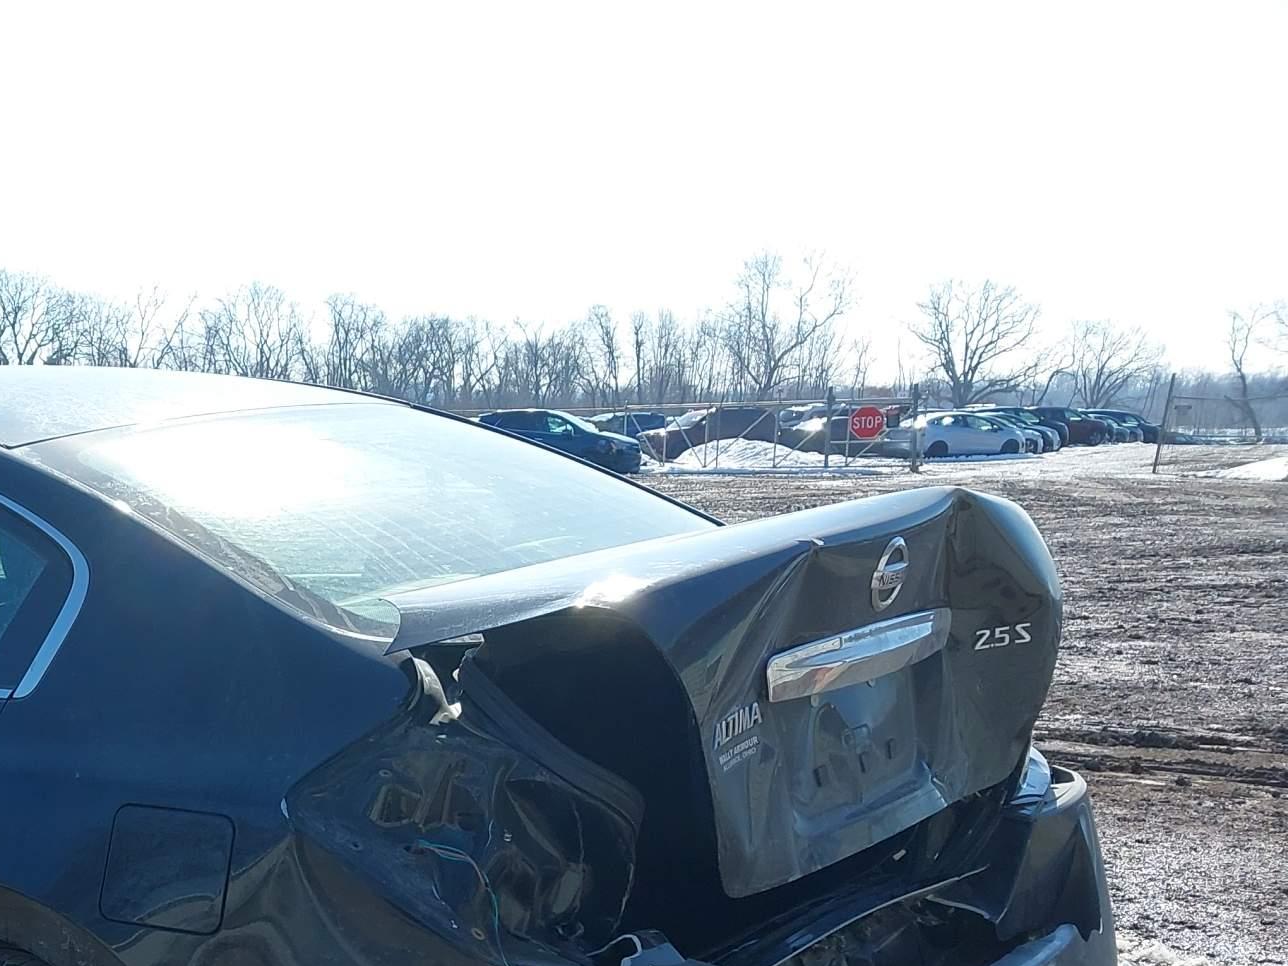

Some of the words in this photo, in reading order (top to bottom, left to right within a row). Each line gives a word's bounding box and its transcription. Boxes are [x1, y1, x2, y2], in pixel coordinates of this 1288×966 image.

[853, 416, 882, 429] STOP
[974, 625, 1010, 651] 2.5
[1014, 622, 1032, 645] S
[713, 702, 762, 751] ALTIMA
